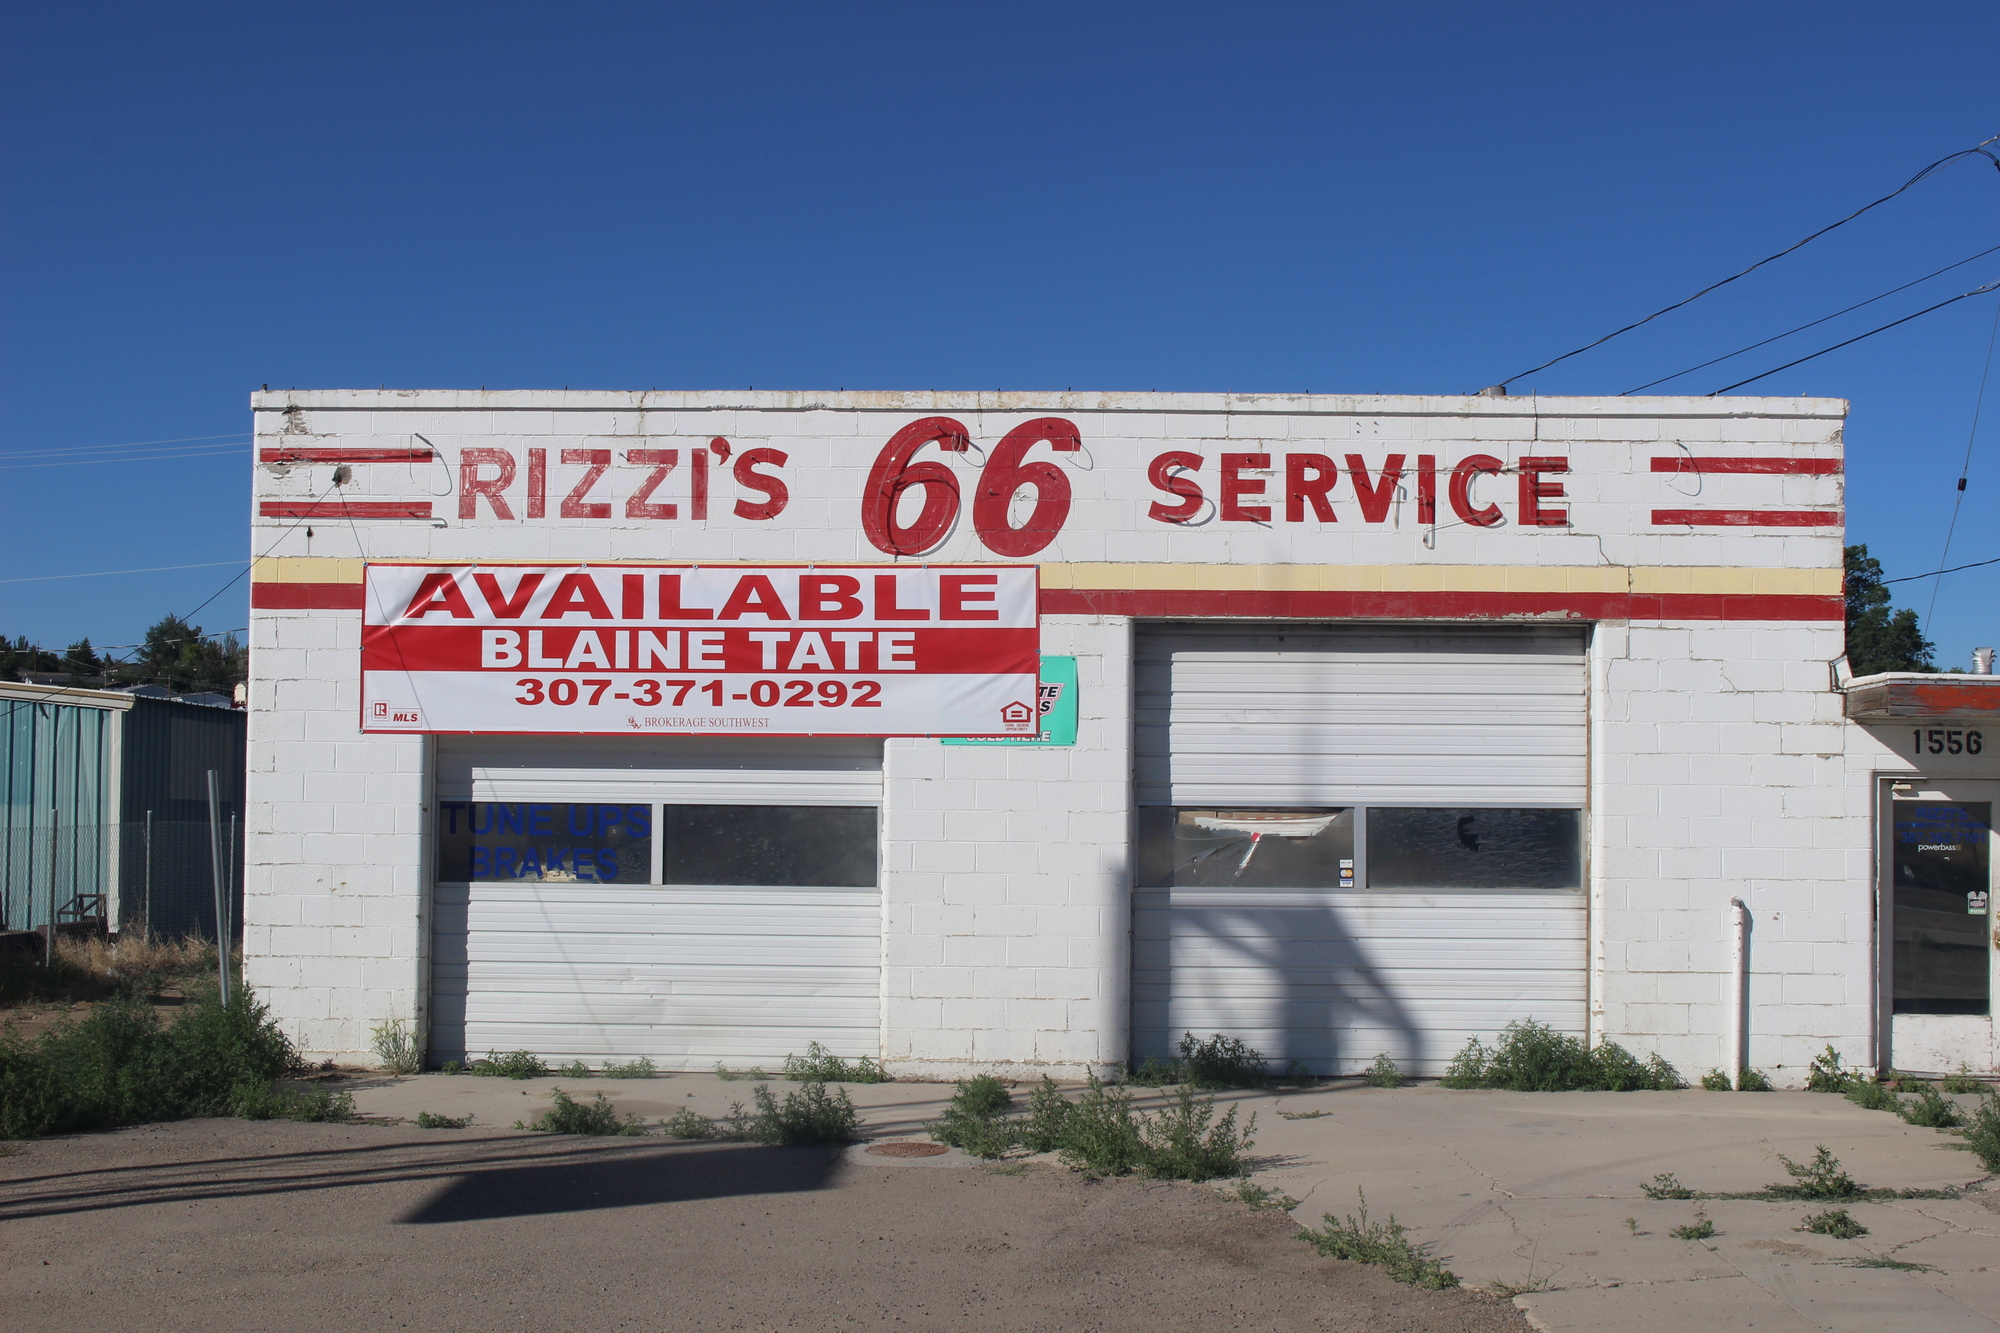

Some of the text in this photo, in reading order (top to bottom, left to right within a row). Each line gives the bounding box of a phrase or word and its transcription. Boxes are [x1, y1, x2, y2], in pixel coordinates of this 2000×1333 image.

[459, 416, 1569, 558] RIZZI'S 66 SERVICE
[403, 572, 999, 622] AVAILABLE
[481, 629, 916, 671] BLAINE TATE
[515, 678, 882, 708] 307-371-0292
[393, 713, 418, 722] MLS
[644, 717, 706, 728] BROKERAGE
[708, 717, 770, 728] SOUTHWEST
[1913, 729, 1983, 755] 1556
[441, 803, 651, 838] TUNE UPS
[1915, 807, 1969, 820] RIZZI'S
[1901, 832, 1986, 843] 307-362-7101
[469, 846, 618, 880] BRAKES
